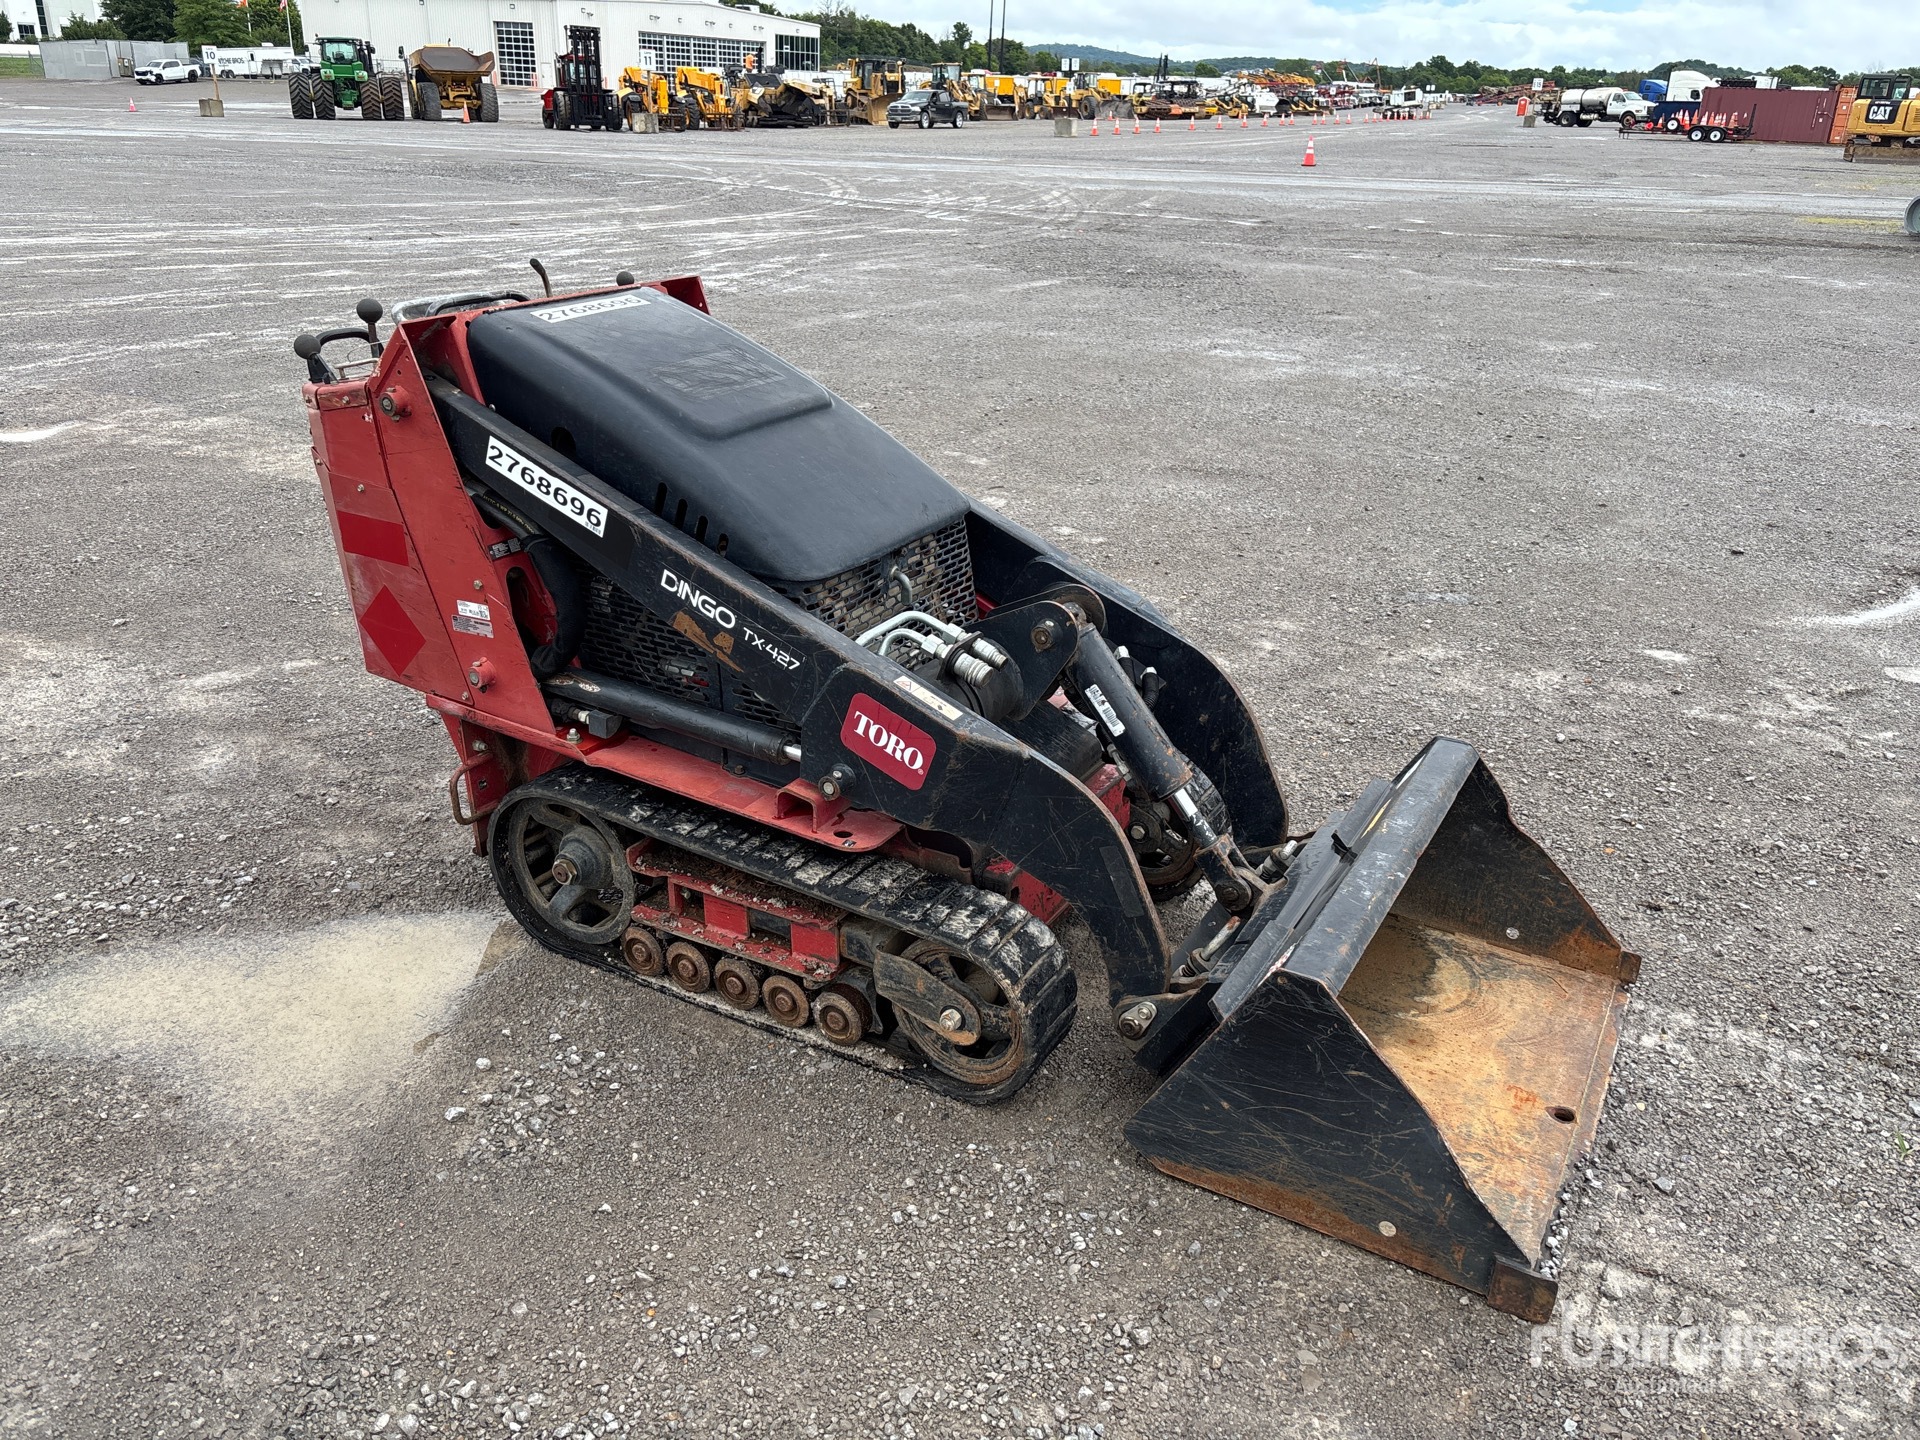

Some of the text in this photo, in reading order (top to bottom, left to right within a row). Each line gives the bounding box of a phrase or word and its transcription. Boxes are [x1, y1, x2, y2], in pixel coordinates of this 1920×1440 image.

[205, 51, 215, 59] 10
[643, 56, 652, 65] 11
[1868, 105, 1893, 120] CAT
[539, 297, 642, 320] 2768696
[488, 445, 602, 528] 2768696
[660, 568, 736, 629] DINGO
[853, 710, 924, 770] TORO
